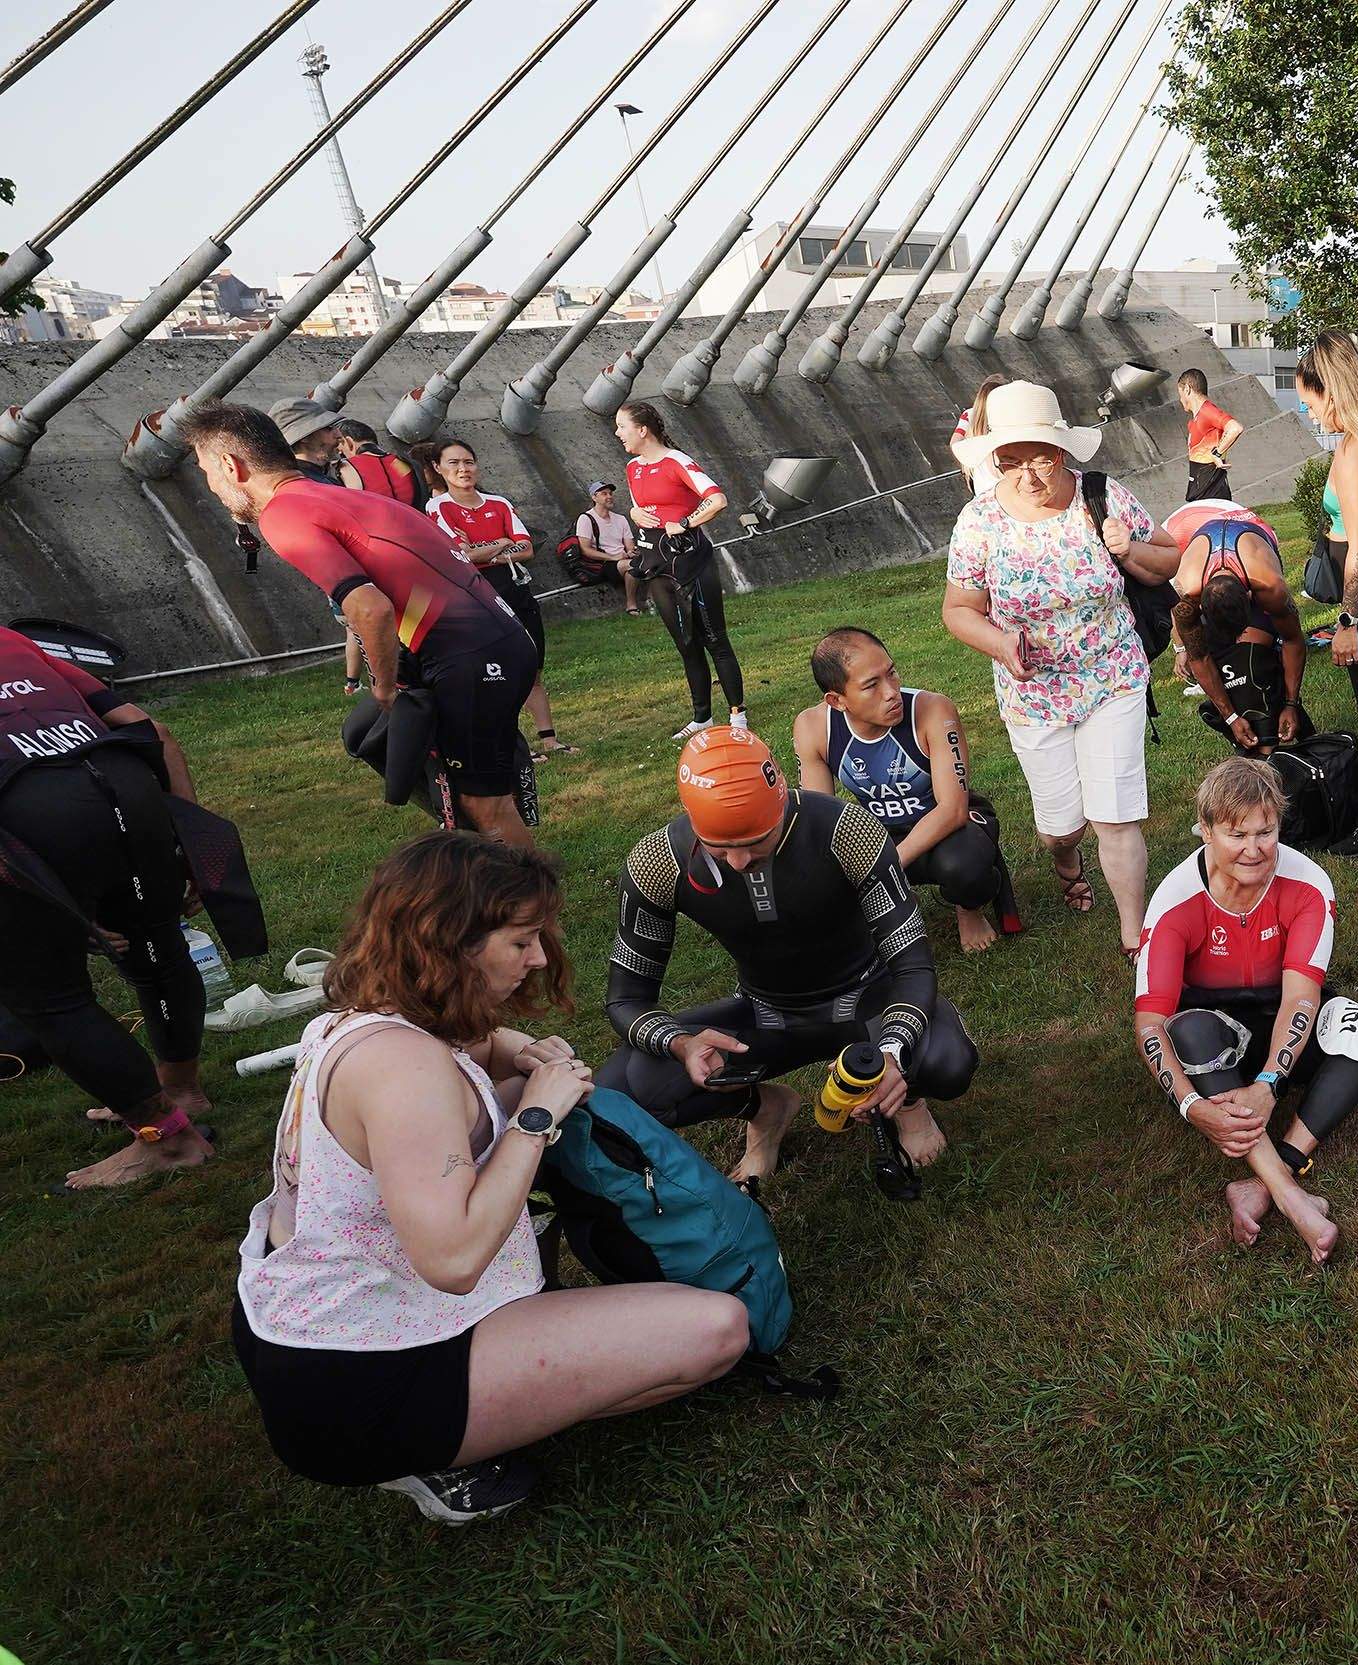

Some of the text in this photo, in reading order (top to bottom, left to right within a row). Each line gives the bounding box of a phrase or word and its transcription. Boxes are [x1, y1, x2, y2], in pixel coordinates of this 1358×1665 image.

[7, 719, 98, 758] ALONSO
[947, 731, 968, 793] 6151
[859, 782, 912, 800] YAP
[868, 797, 926, 818] GBR
